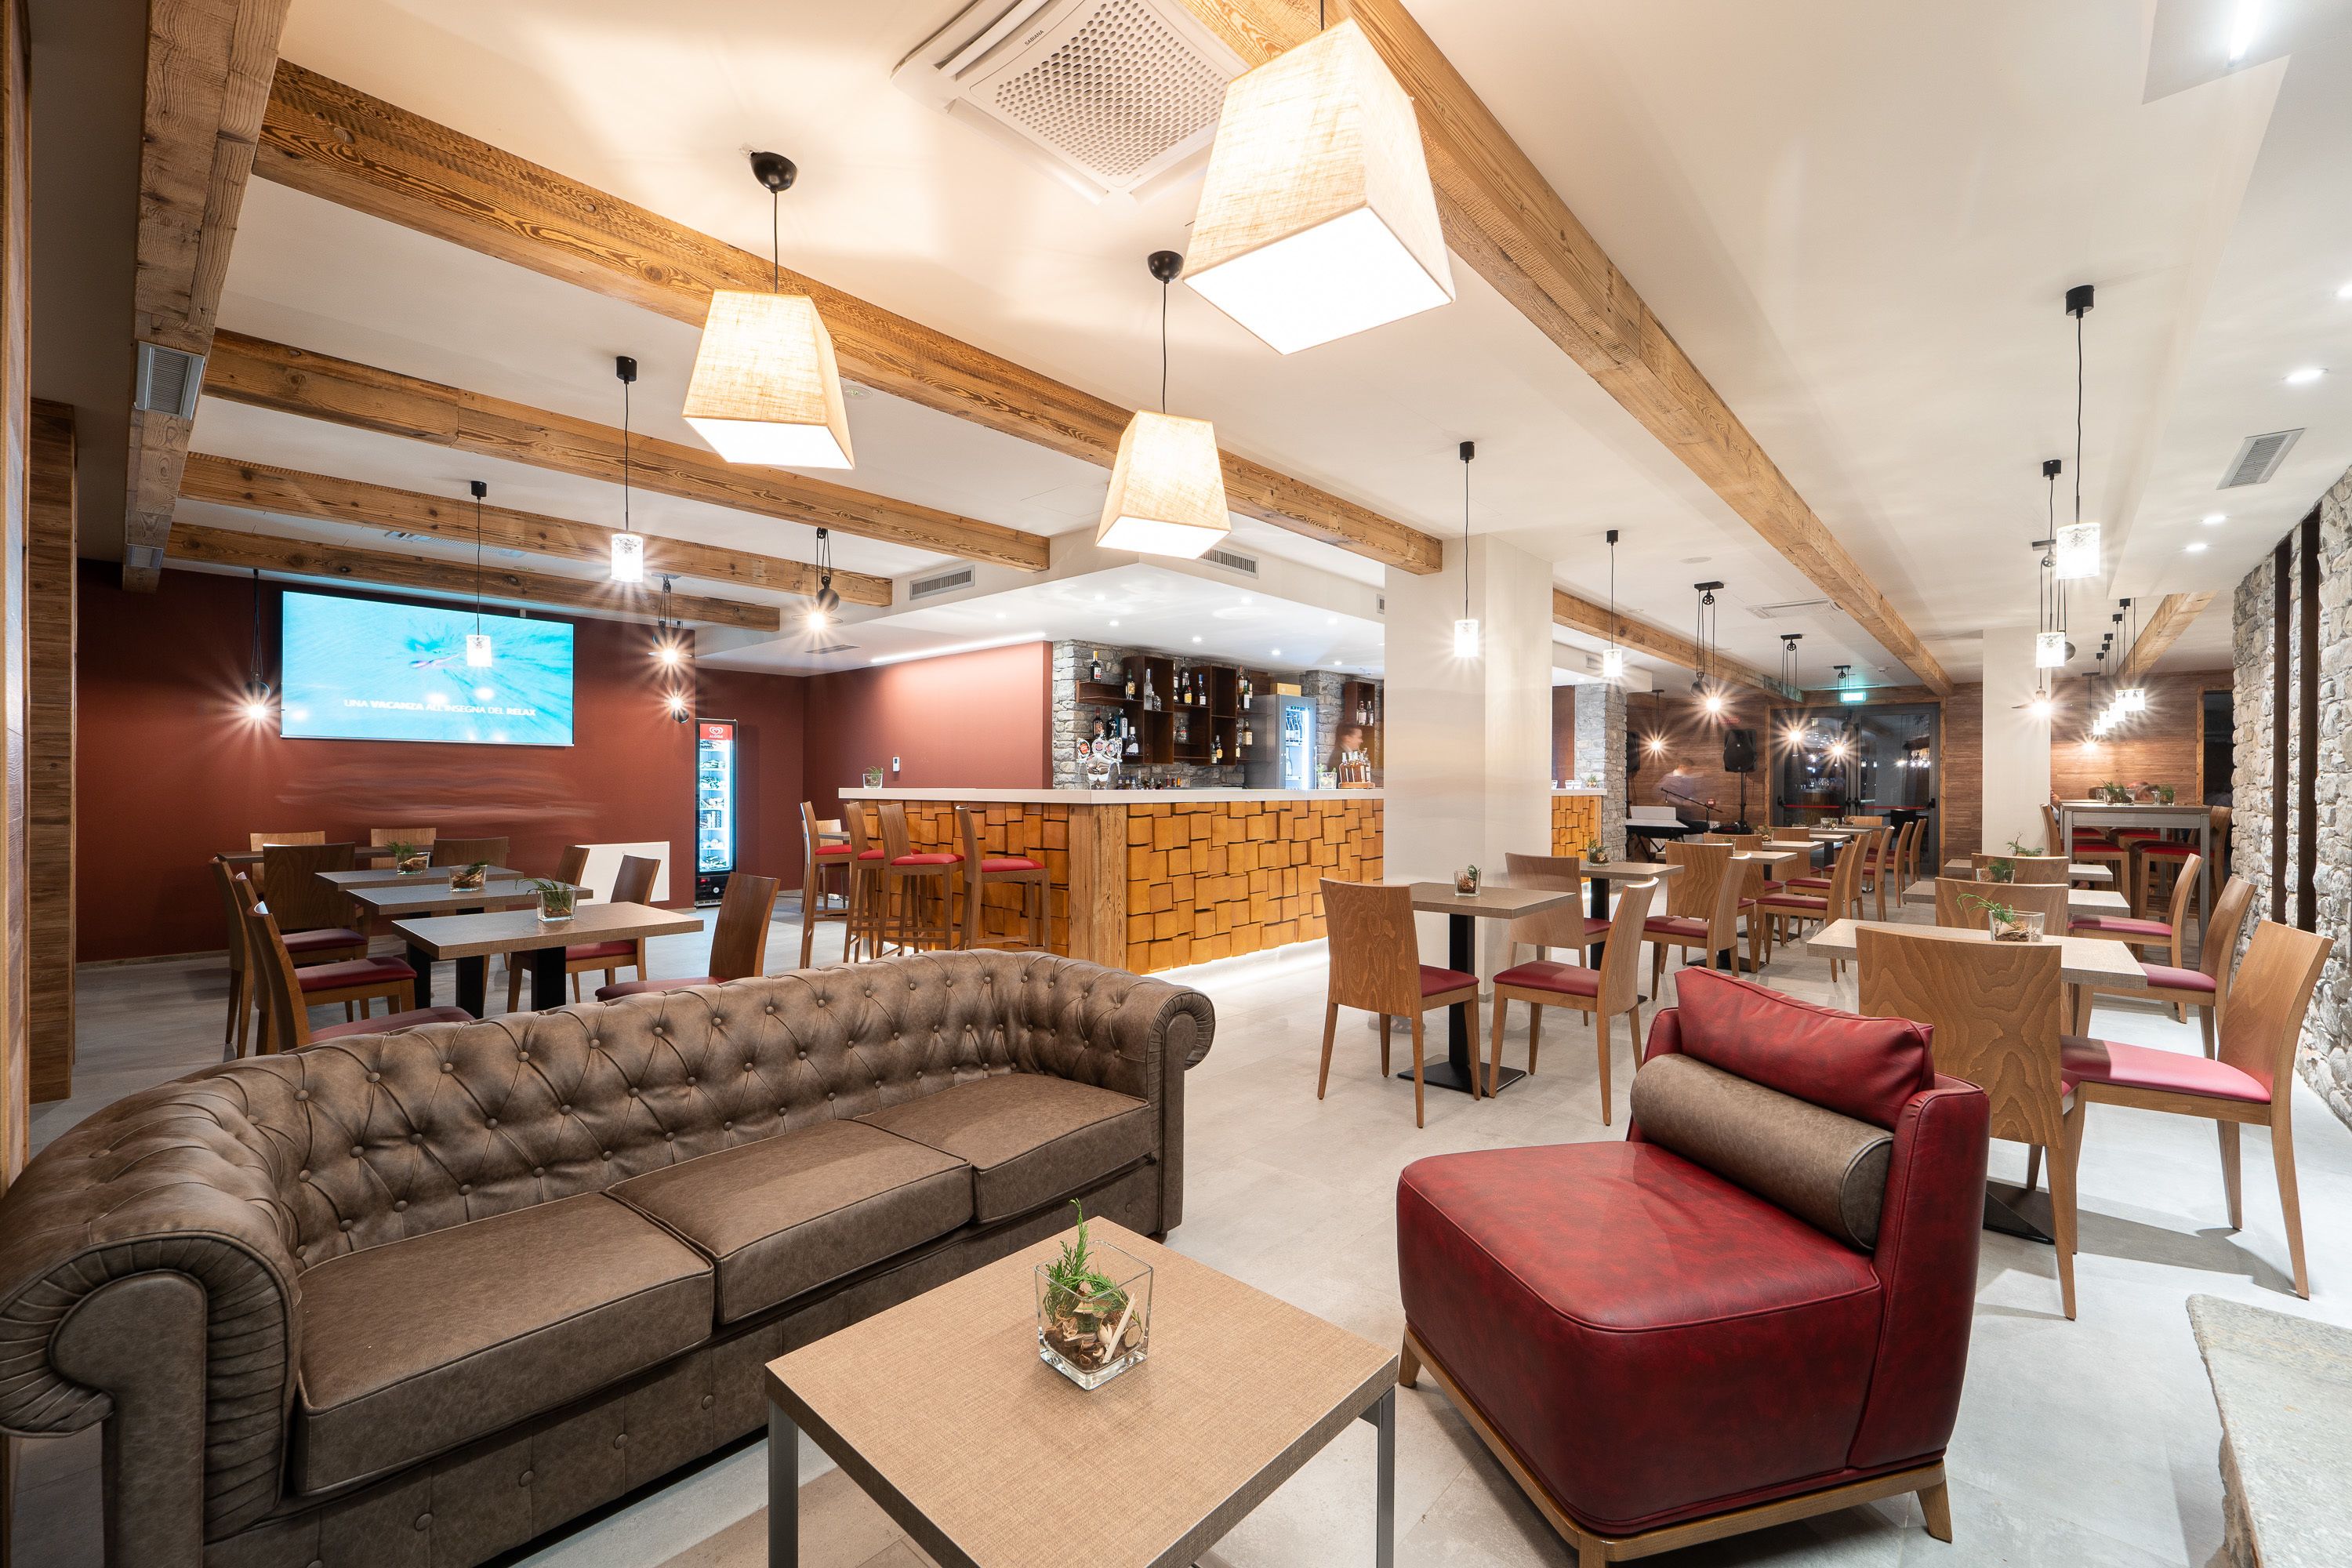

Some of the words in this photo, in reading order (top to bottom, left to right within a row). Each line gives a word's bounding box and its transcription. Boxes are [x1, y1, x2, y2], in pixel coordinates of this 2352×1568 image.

[1024, 30, 1044, 45] SABIANA
[343, 699, 368, 708] UNA
[369, 700, 425, 711] VACANZA
[488, 706, 505, 715] DEL
[506, 707, 536, 717] RELAX
